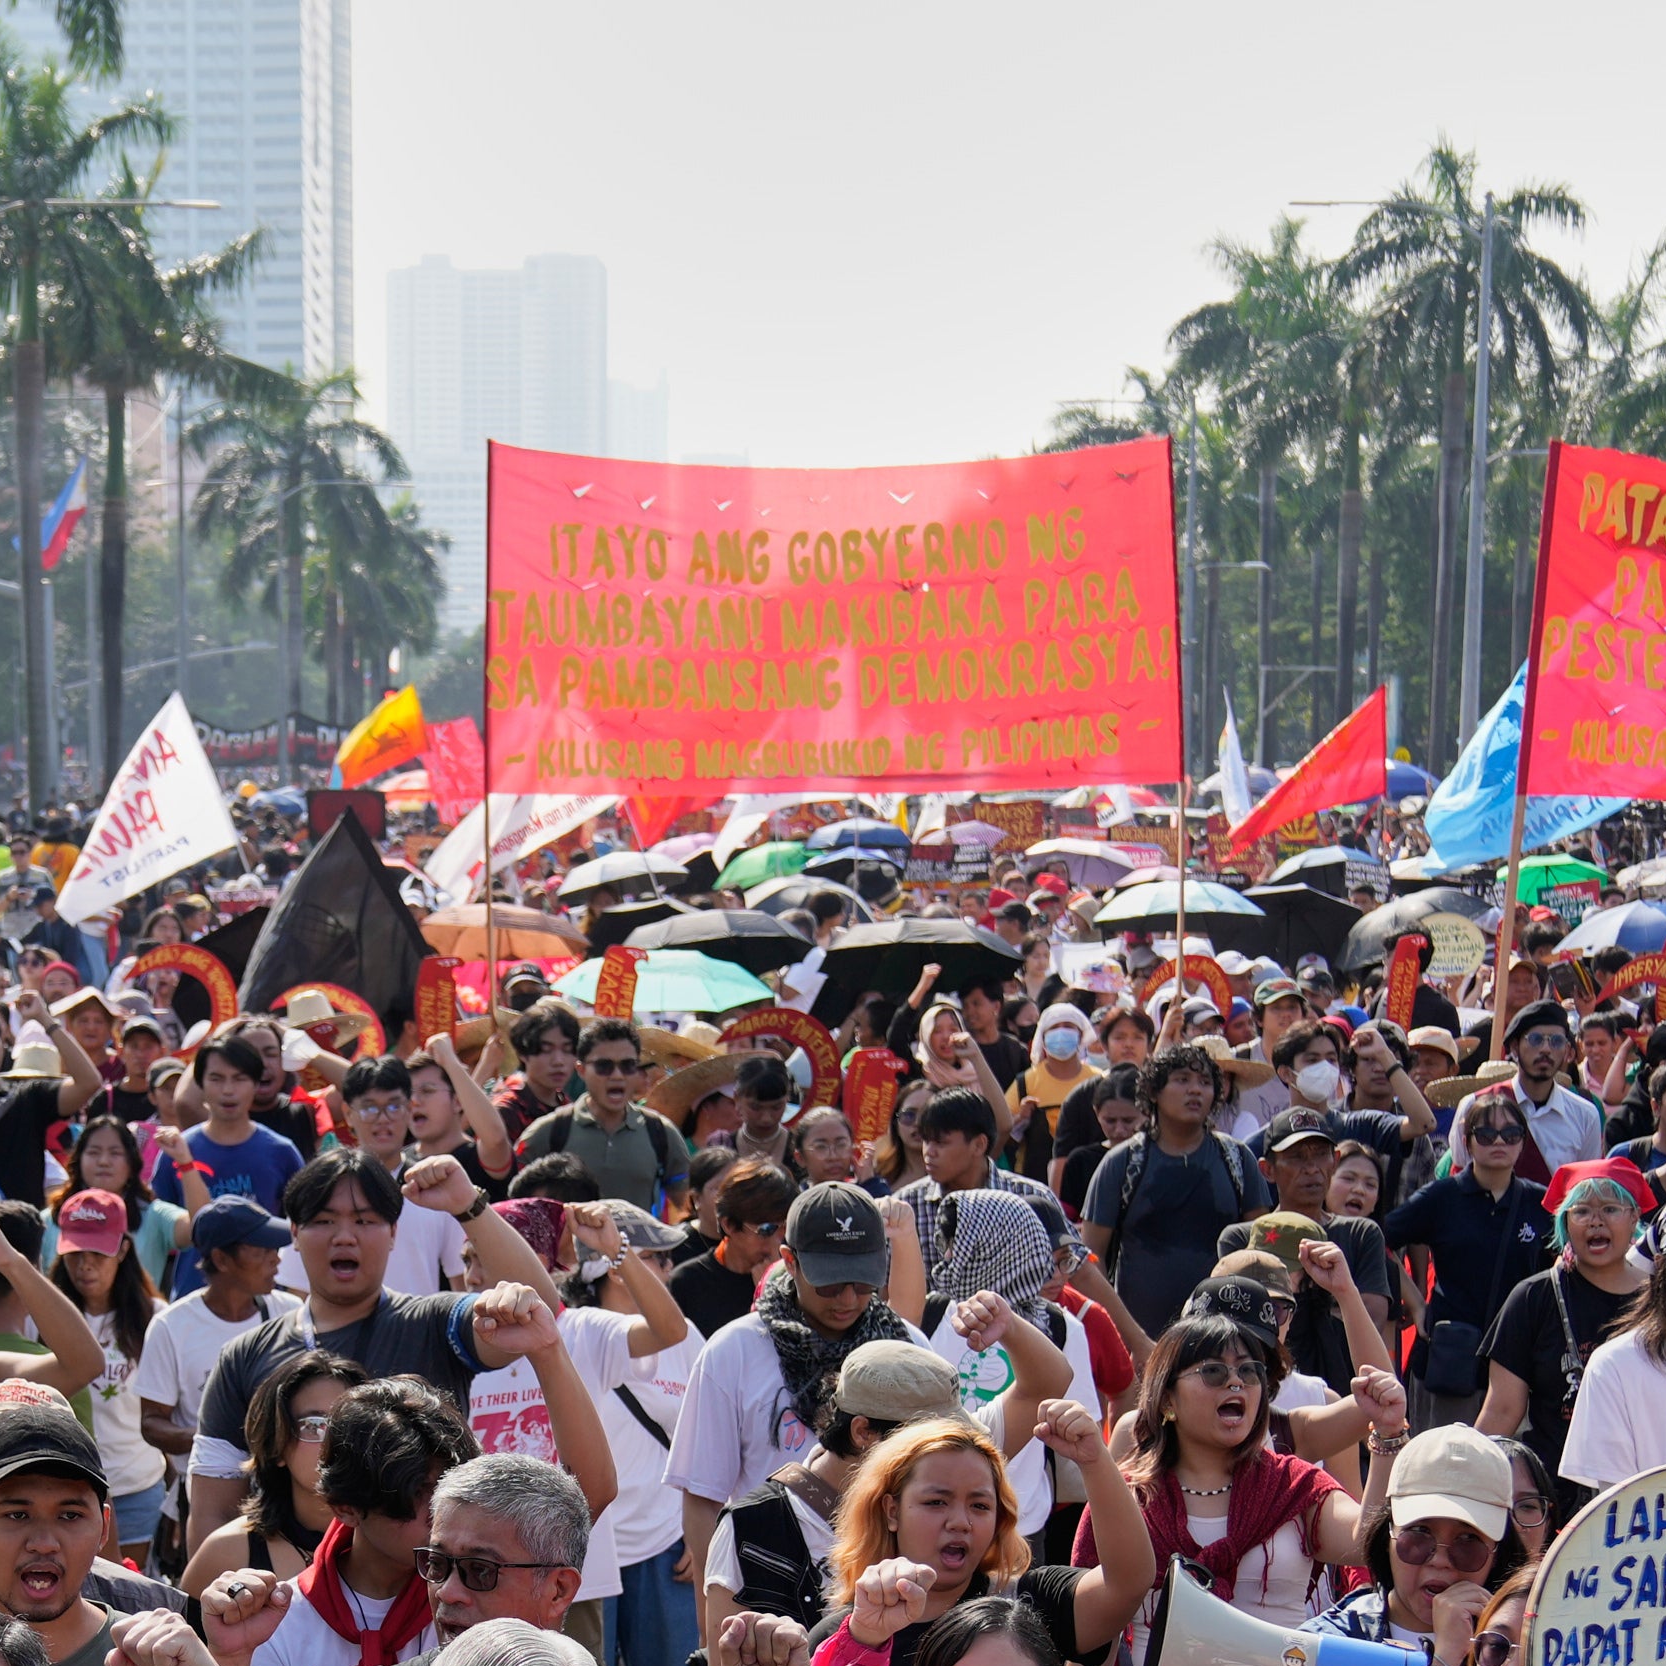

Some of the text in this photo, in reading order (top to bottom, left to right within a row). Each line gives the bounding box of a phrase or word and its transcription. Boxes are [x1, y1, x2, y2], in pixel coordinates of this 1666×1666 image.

[550, 507, 1085, 586] ITAYO ANG GOBYERNO NG
[489, 567, 1139, 653] TAUMBAYAN! MAKIBAKA PARA
[486, 627, 1173, 713] SA PAMBANSANG DEMOKRASYA!
[536, 711, 1119, 781] KILUSANG MAGBUBUKID NG PILIPINAS
[486, 1391, 518, 1406] THEIR
[1562, 1565, 1600, 1600] NG
